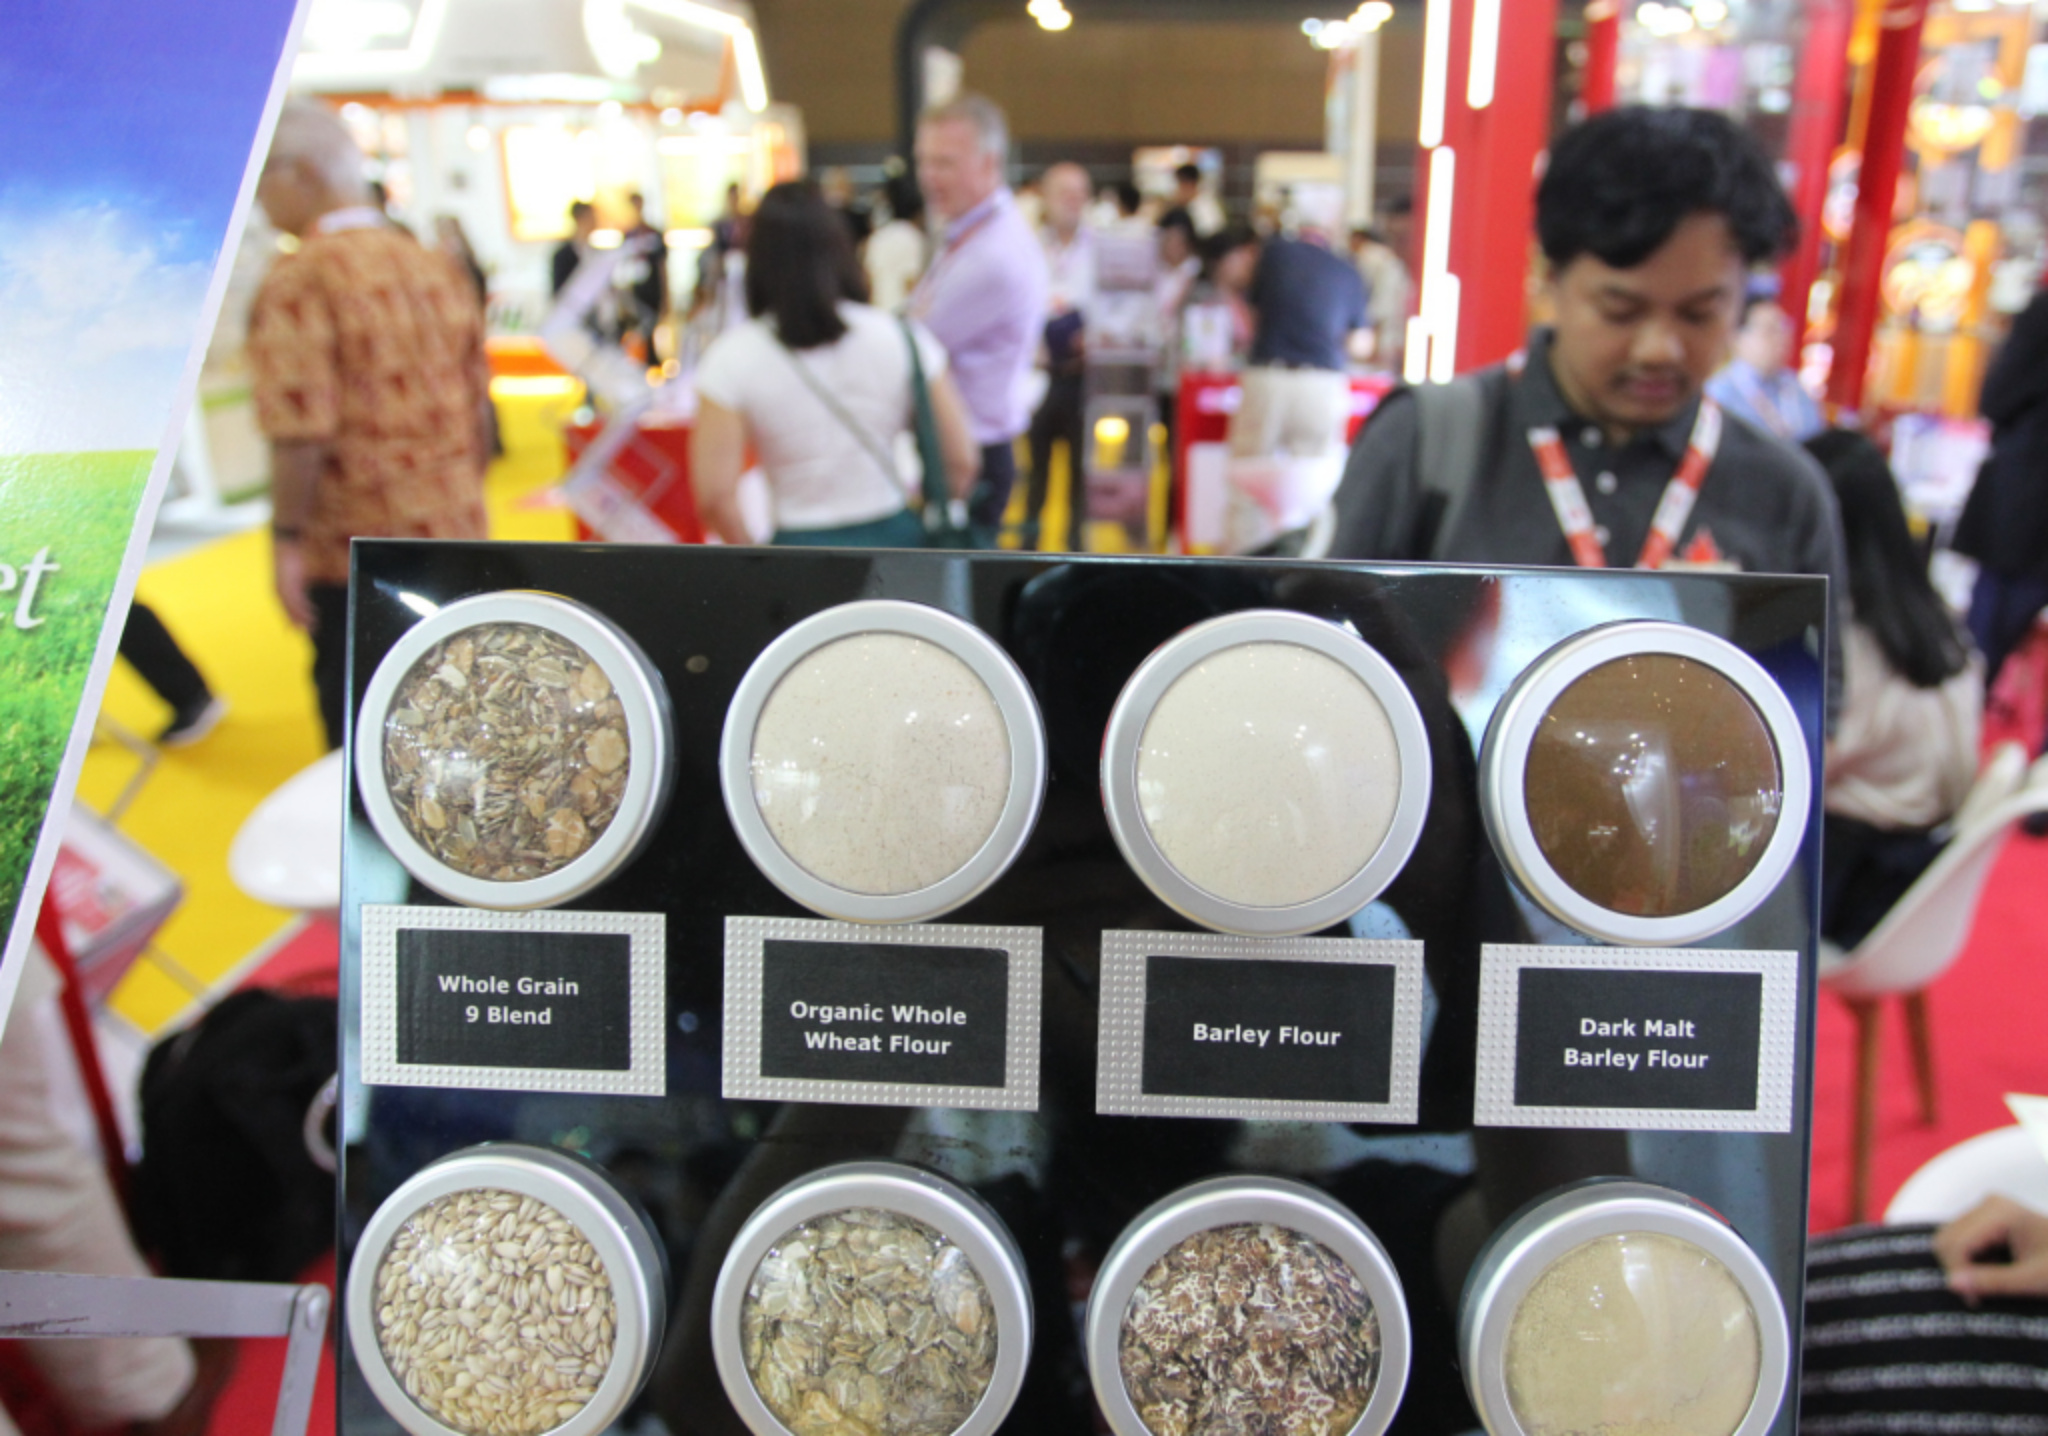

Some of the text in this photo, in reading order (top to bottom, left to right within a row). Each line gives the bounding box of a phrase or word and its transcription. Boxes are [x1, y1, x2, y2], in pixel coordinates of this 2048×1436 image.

[438, 975, 579, 995] Whole Grain
[465, 1005, 552, 1025] 9 Blend
[789, 1001, 967, 1025] Organic Whole
[1193, 1023, 1342, 1047] Barley Flour
[1579, 1018, 1695, 1039] Dark Malt
[804, 1031, 952, 1055] Wheat Flour
[1563, 1047, 1709, 1070] Barley Flour
